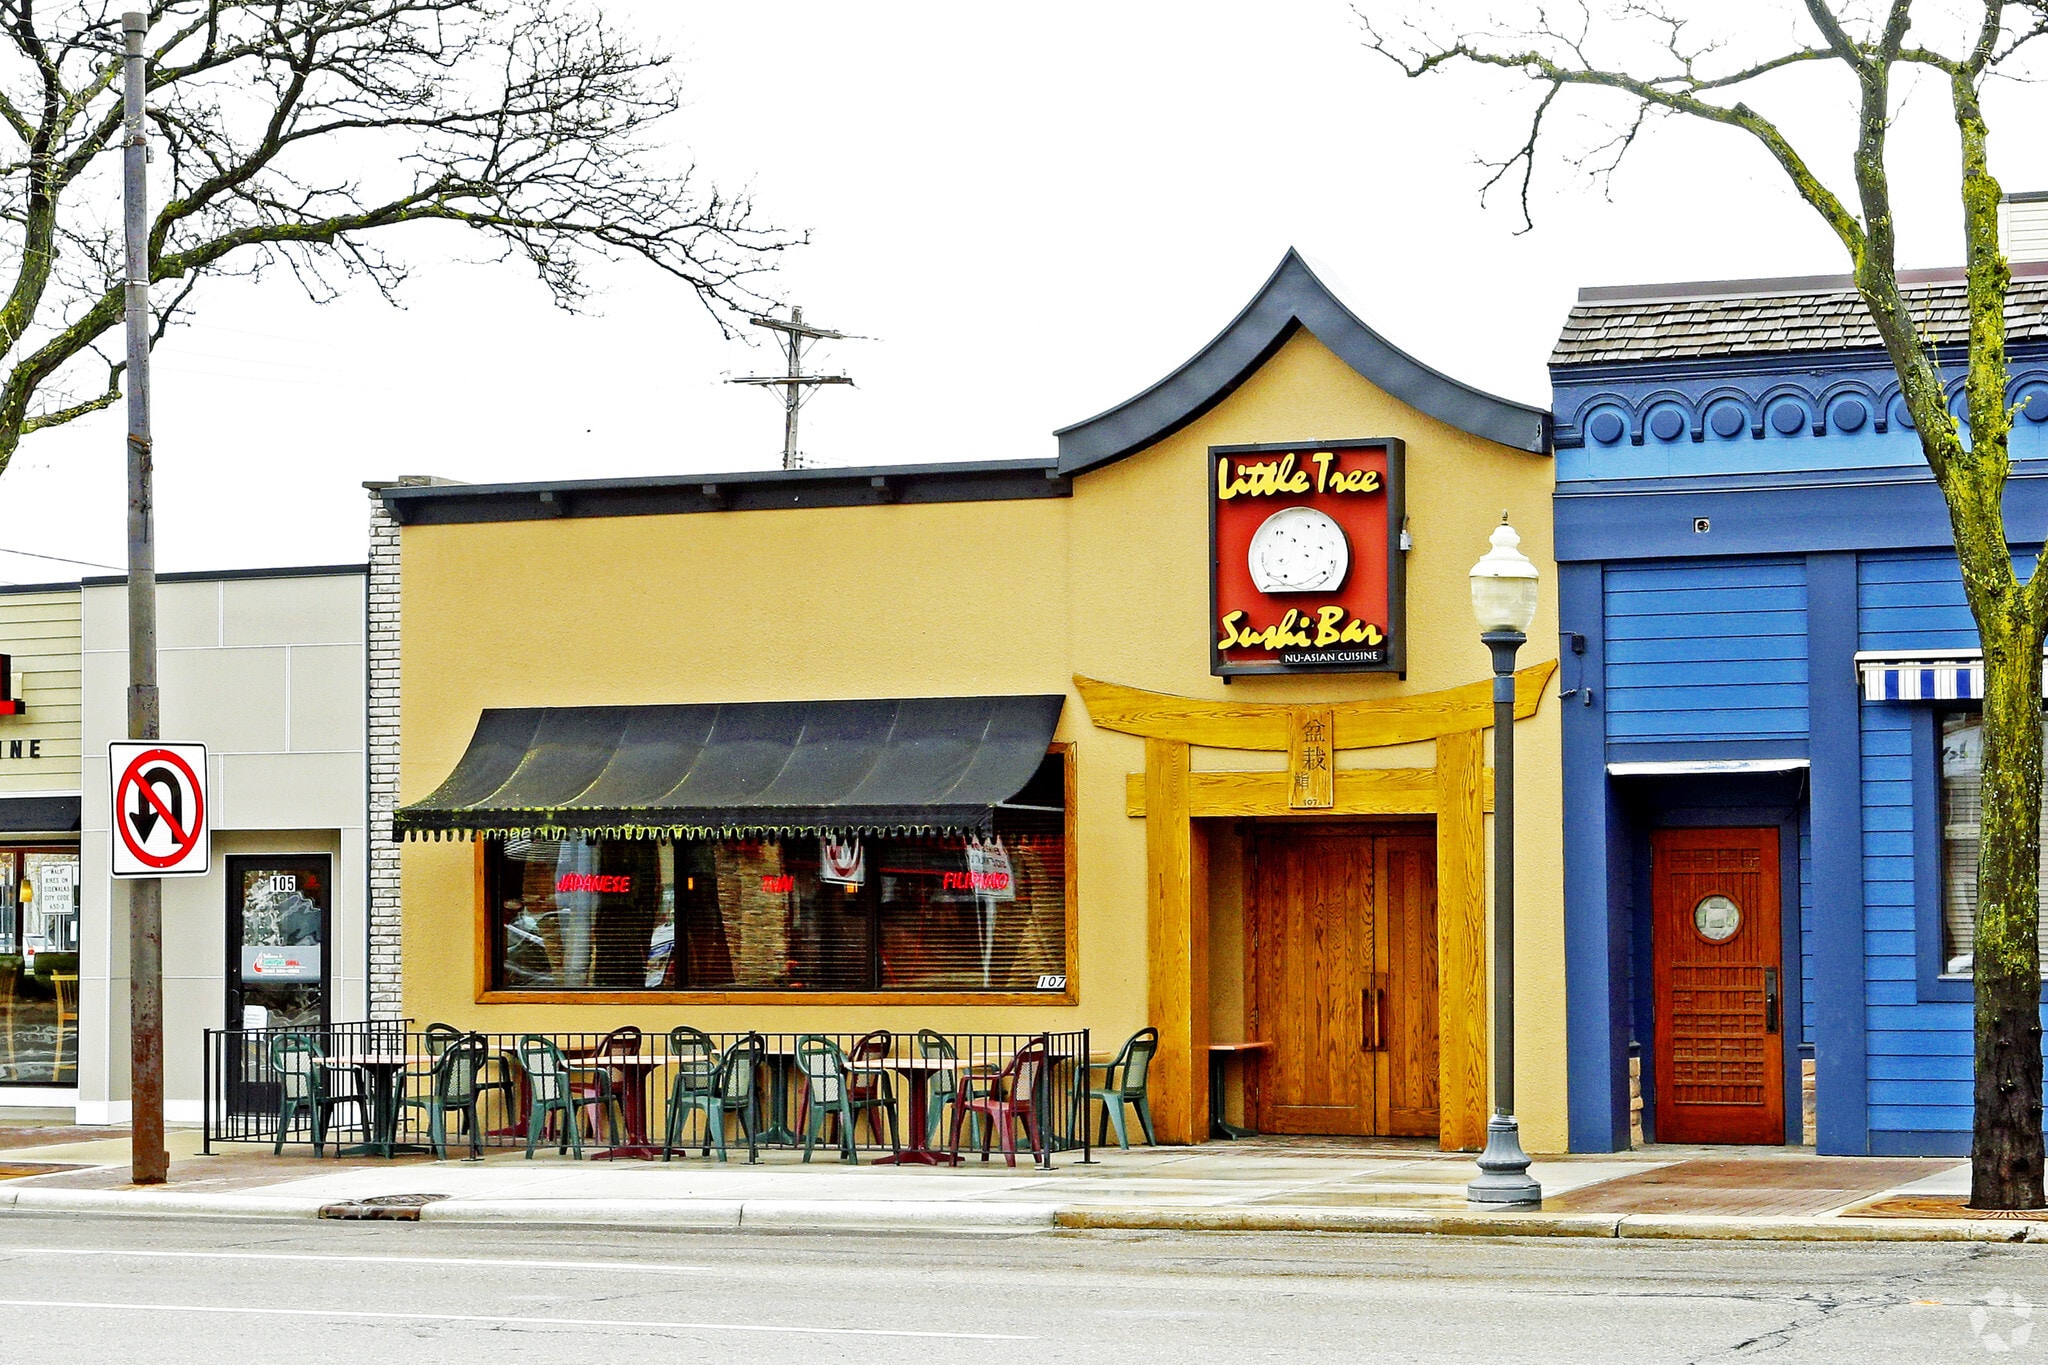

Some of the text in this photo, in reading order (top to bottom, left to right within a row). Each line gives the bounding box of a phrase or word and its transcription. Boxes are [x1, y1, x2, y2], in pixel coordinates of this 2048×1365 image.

[1218, 452, 1380, 500] Little Tree
[1217, 605, 1383, 651] Sushi Bar
[1284, 651, 1378, 663] NU-ASIAN CUISINE
[1304, 798, 1318, 806] 107
[271, 876, 294, 891] 105
[556, 872, 631, 893] JAPANESE
[761, 873, 795, 893] THAI
[1040, 976, 1066, 988] 107
